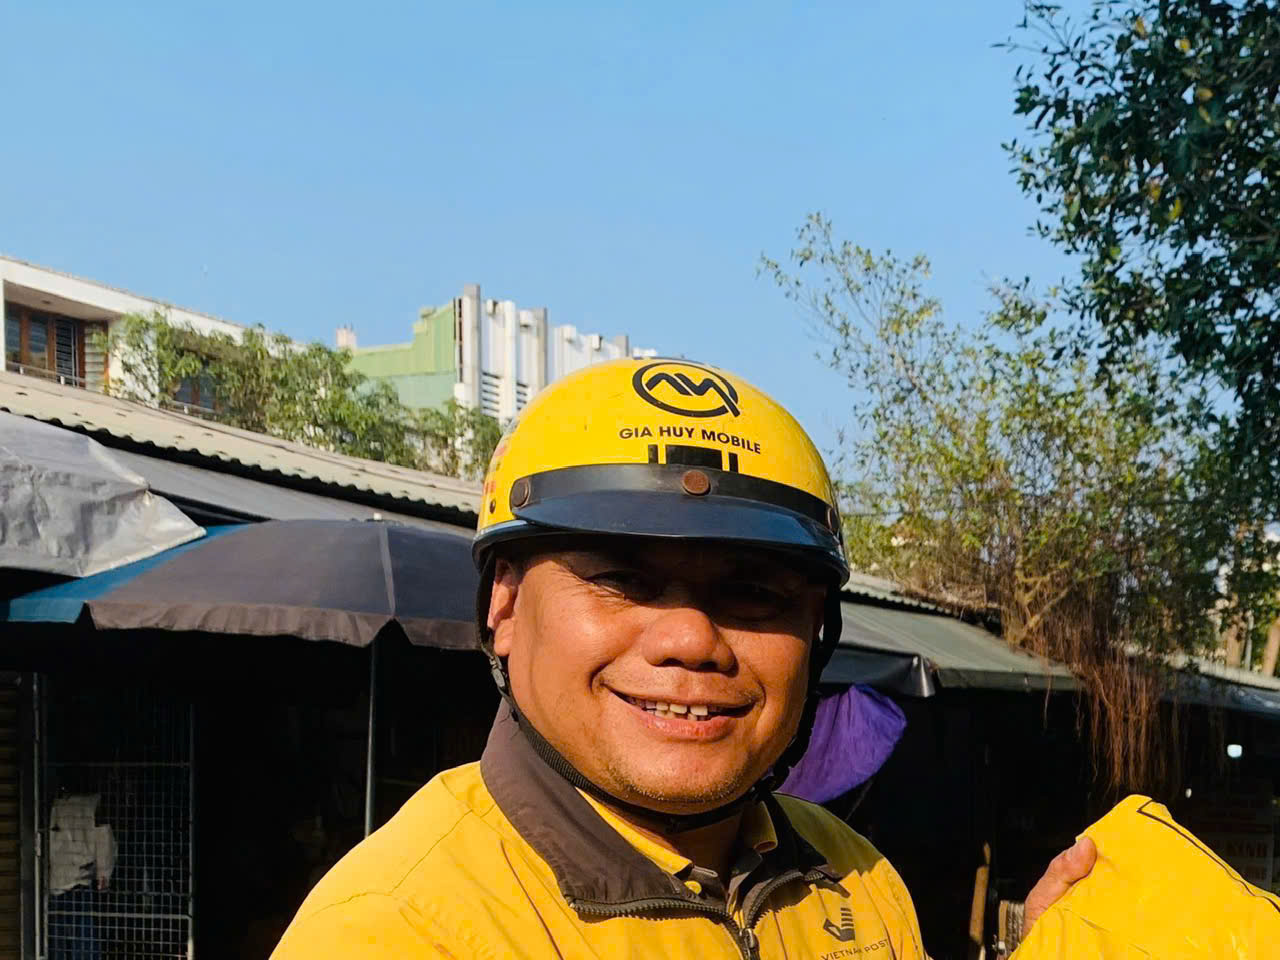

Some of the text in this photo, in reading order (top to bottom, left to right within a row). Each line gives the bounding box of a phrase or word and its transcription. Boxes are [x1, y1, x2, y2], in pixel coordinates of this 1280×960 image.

[619, 426, 761, 455] GIA HUY MOBILE
[864, 938, 889, 953] POST
